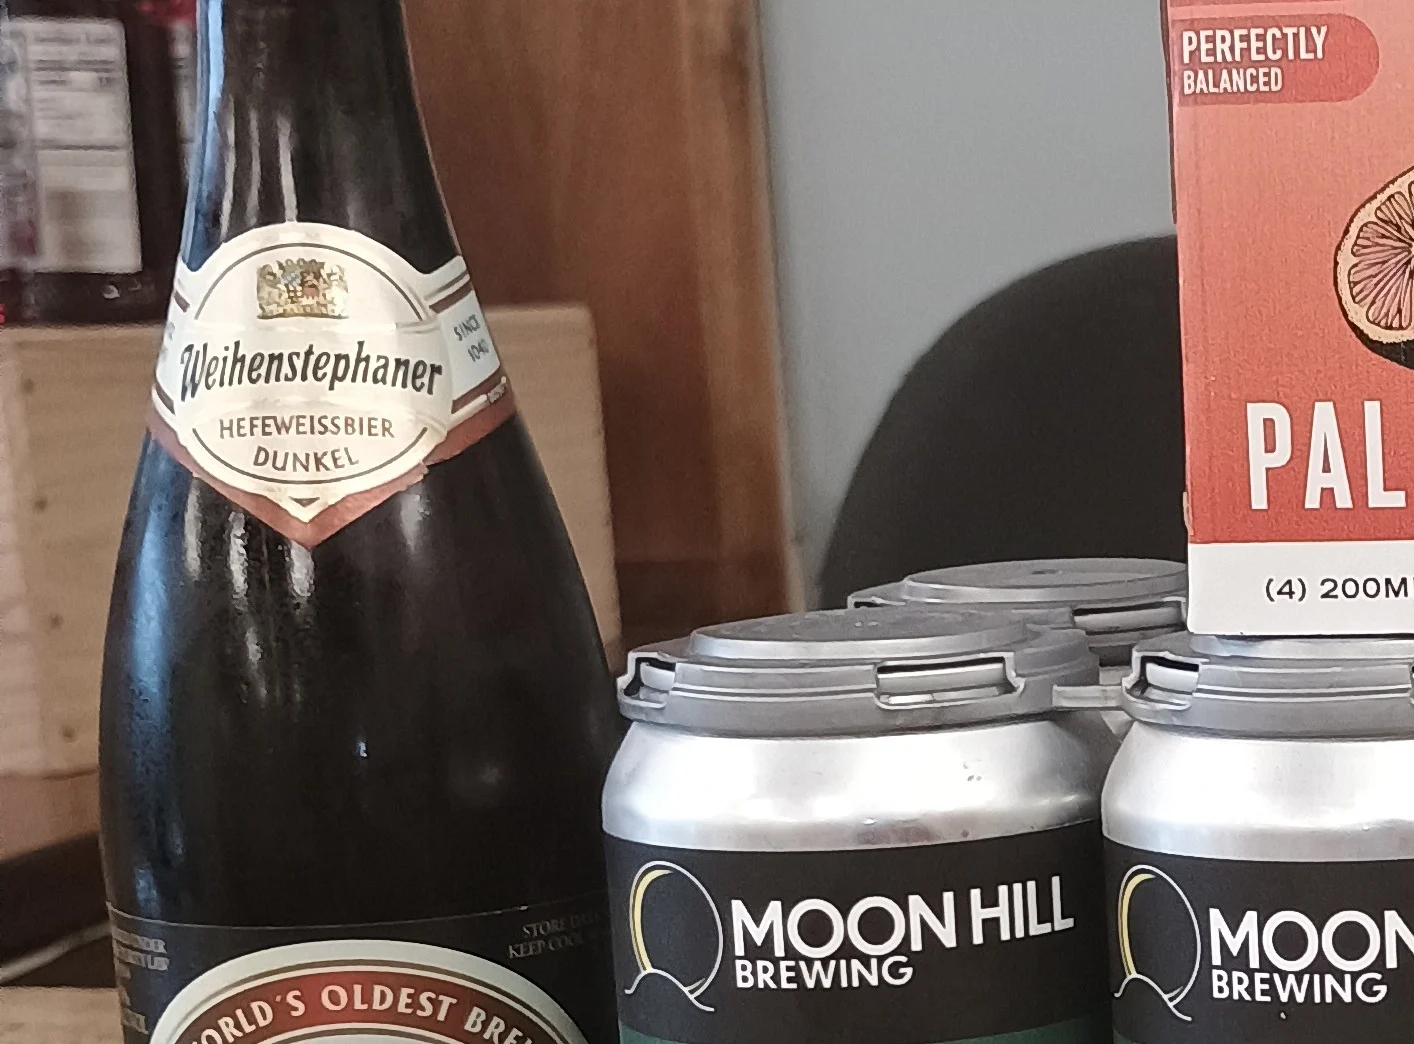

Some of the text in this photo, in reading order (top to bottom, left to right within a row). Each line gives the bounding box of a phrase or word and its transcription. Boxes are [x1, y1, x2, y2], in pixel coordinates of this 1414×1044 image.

[1181, 25, 1329, 65] PERFECTLY
[1181, 67, 1284, 97] BALANCED
[180, 340, 442, 401] Weihenstephaner
[219, 415, 394, 439] HEFEWEISSBIER
[253, 445, 359, 472] DUNKEL
[1263, 575, 1309, 603] (4)
[731, 875, 1074, 958] MOON HILL
[735, 954, 913, 989] BREWING
[1211, 969, 1388, 1003] BREWING
[321, 984, 457, 1022] OLDEST
